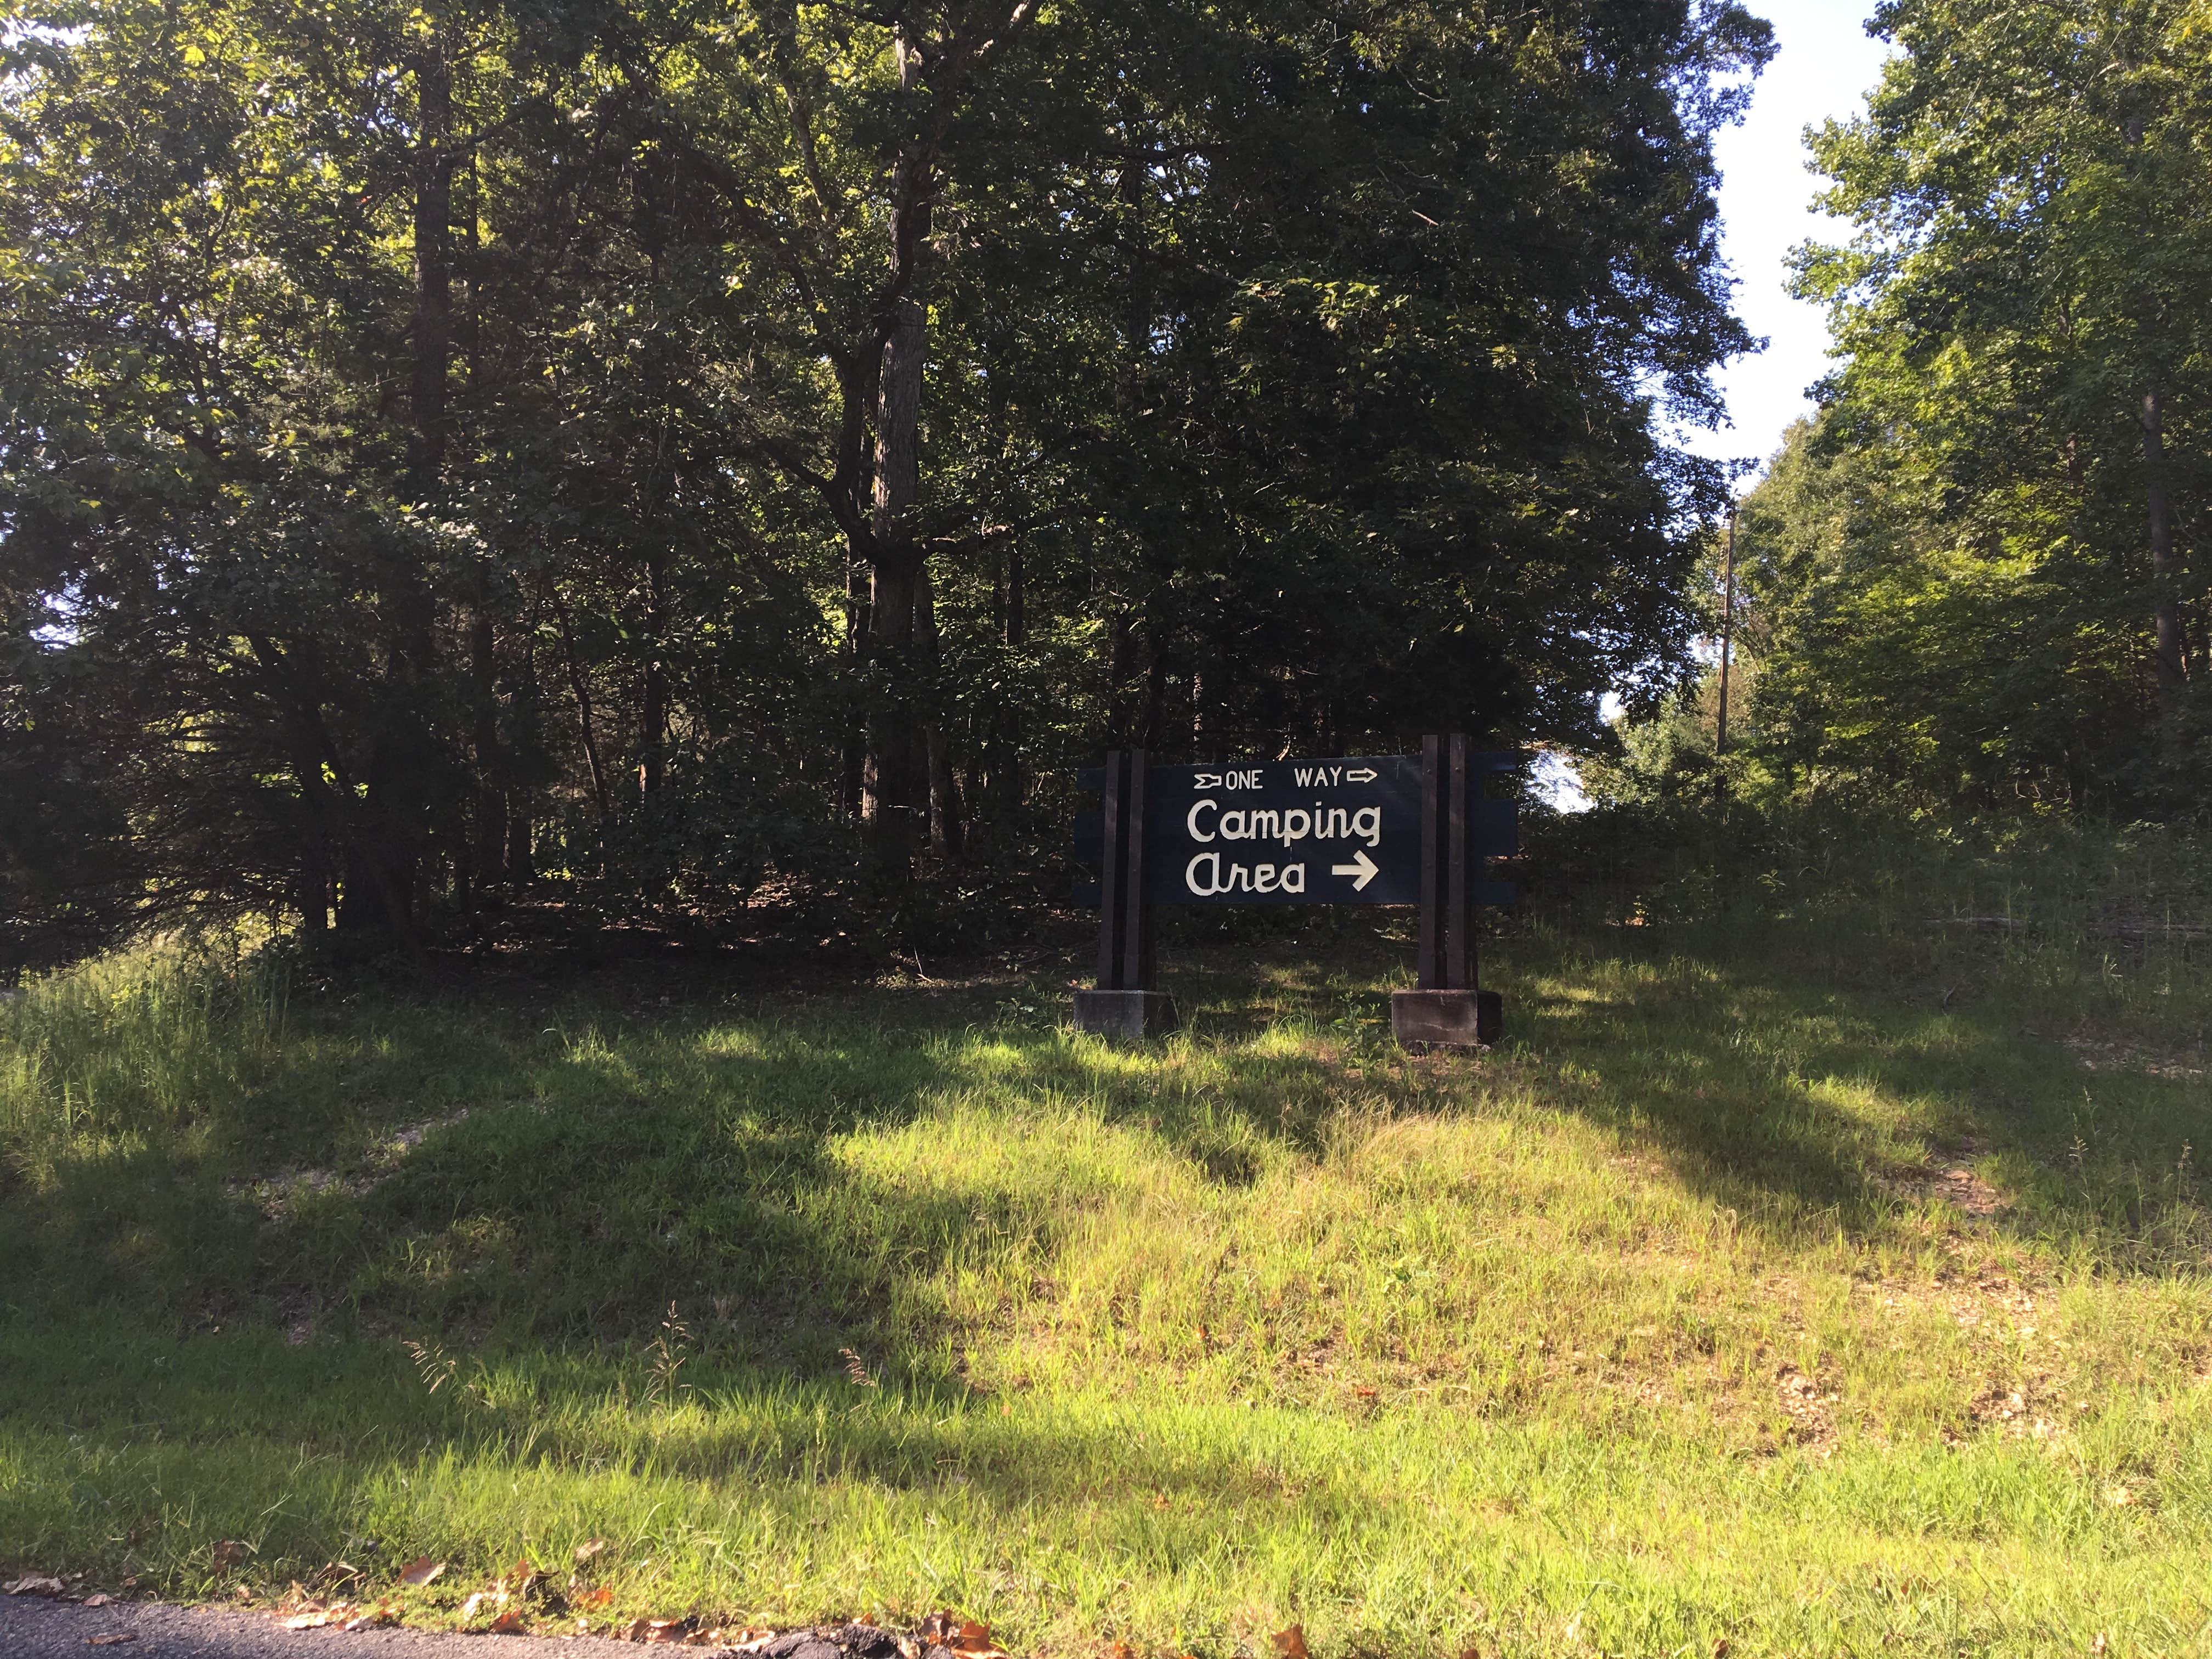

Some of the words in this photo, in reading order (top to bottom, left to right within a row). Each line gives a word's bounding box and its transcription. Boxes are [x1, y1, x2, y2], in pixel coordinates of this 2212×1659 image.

[1226, 769, 1263, 790] ONE
[1294, 766, 1342, 787] WAY
[1187, 799, 1381, 848] Camping
[1186, 852, 1305, 896] Area
